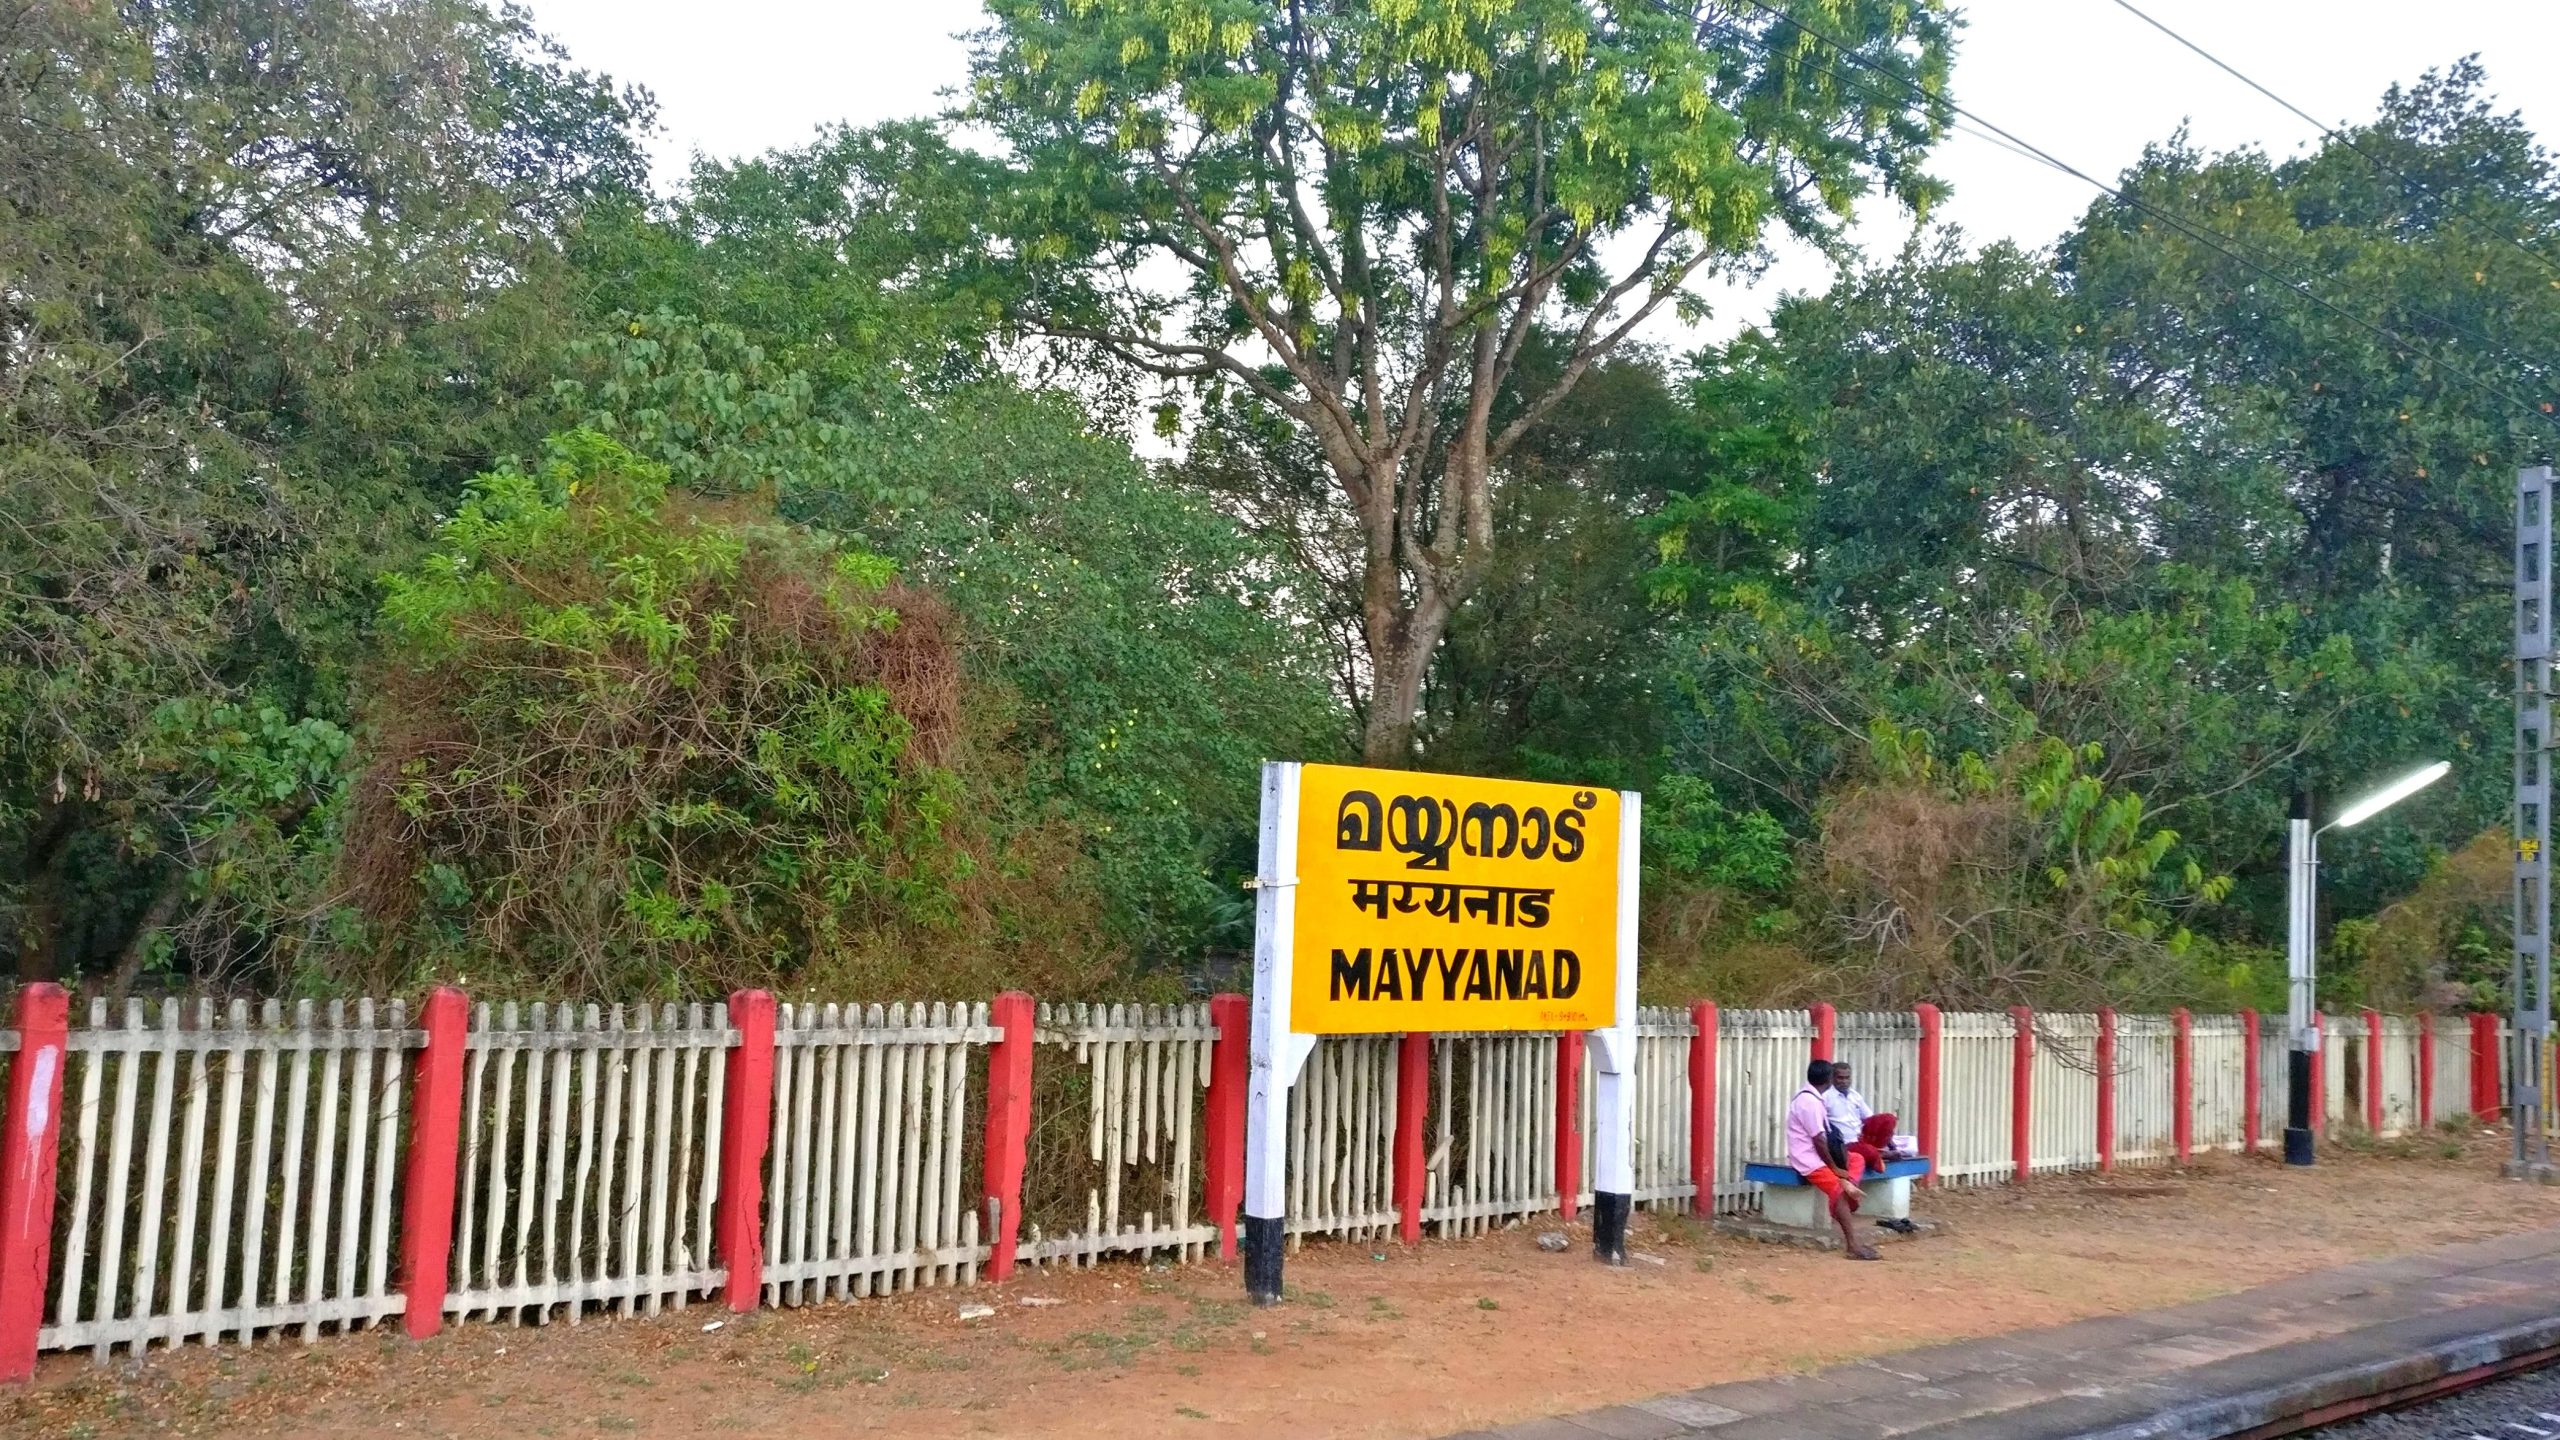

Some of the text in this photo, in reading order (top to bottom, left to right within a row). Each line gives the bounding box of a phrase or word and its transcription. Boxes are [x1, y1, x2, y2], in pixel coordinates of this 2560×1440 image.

[1336, 790, 1598, 871] മയ്യനാട്
[1347, 879, 1555, 928] मय्यनाड
[1329, 948, 1581, 1001] MAYYANAD
